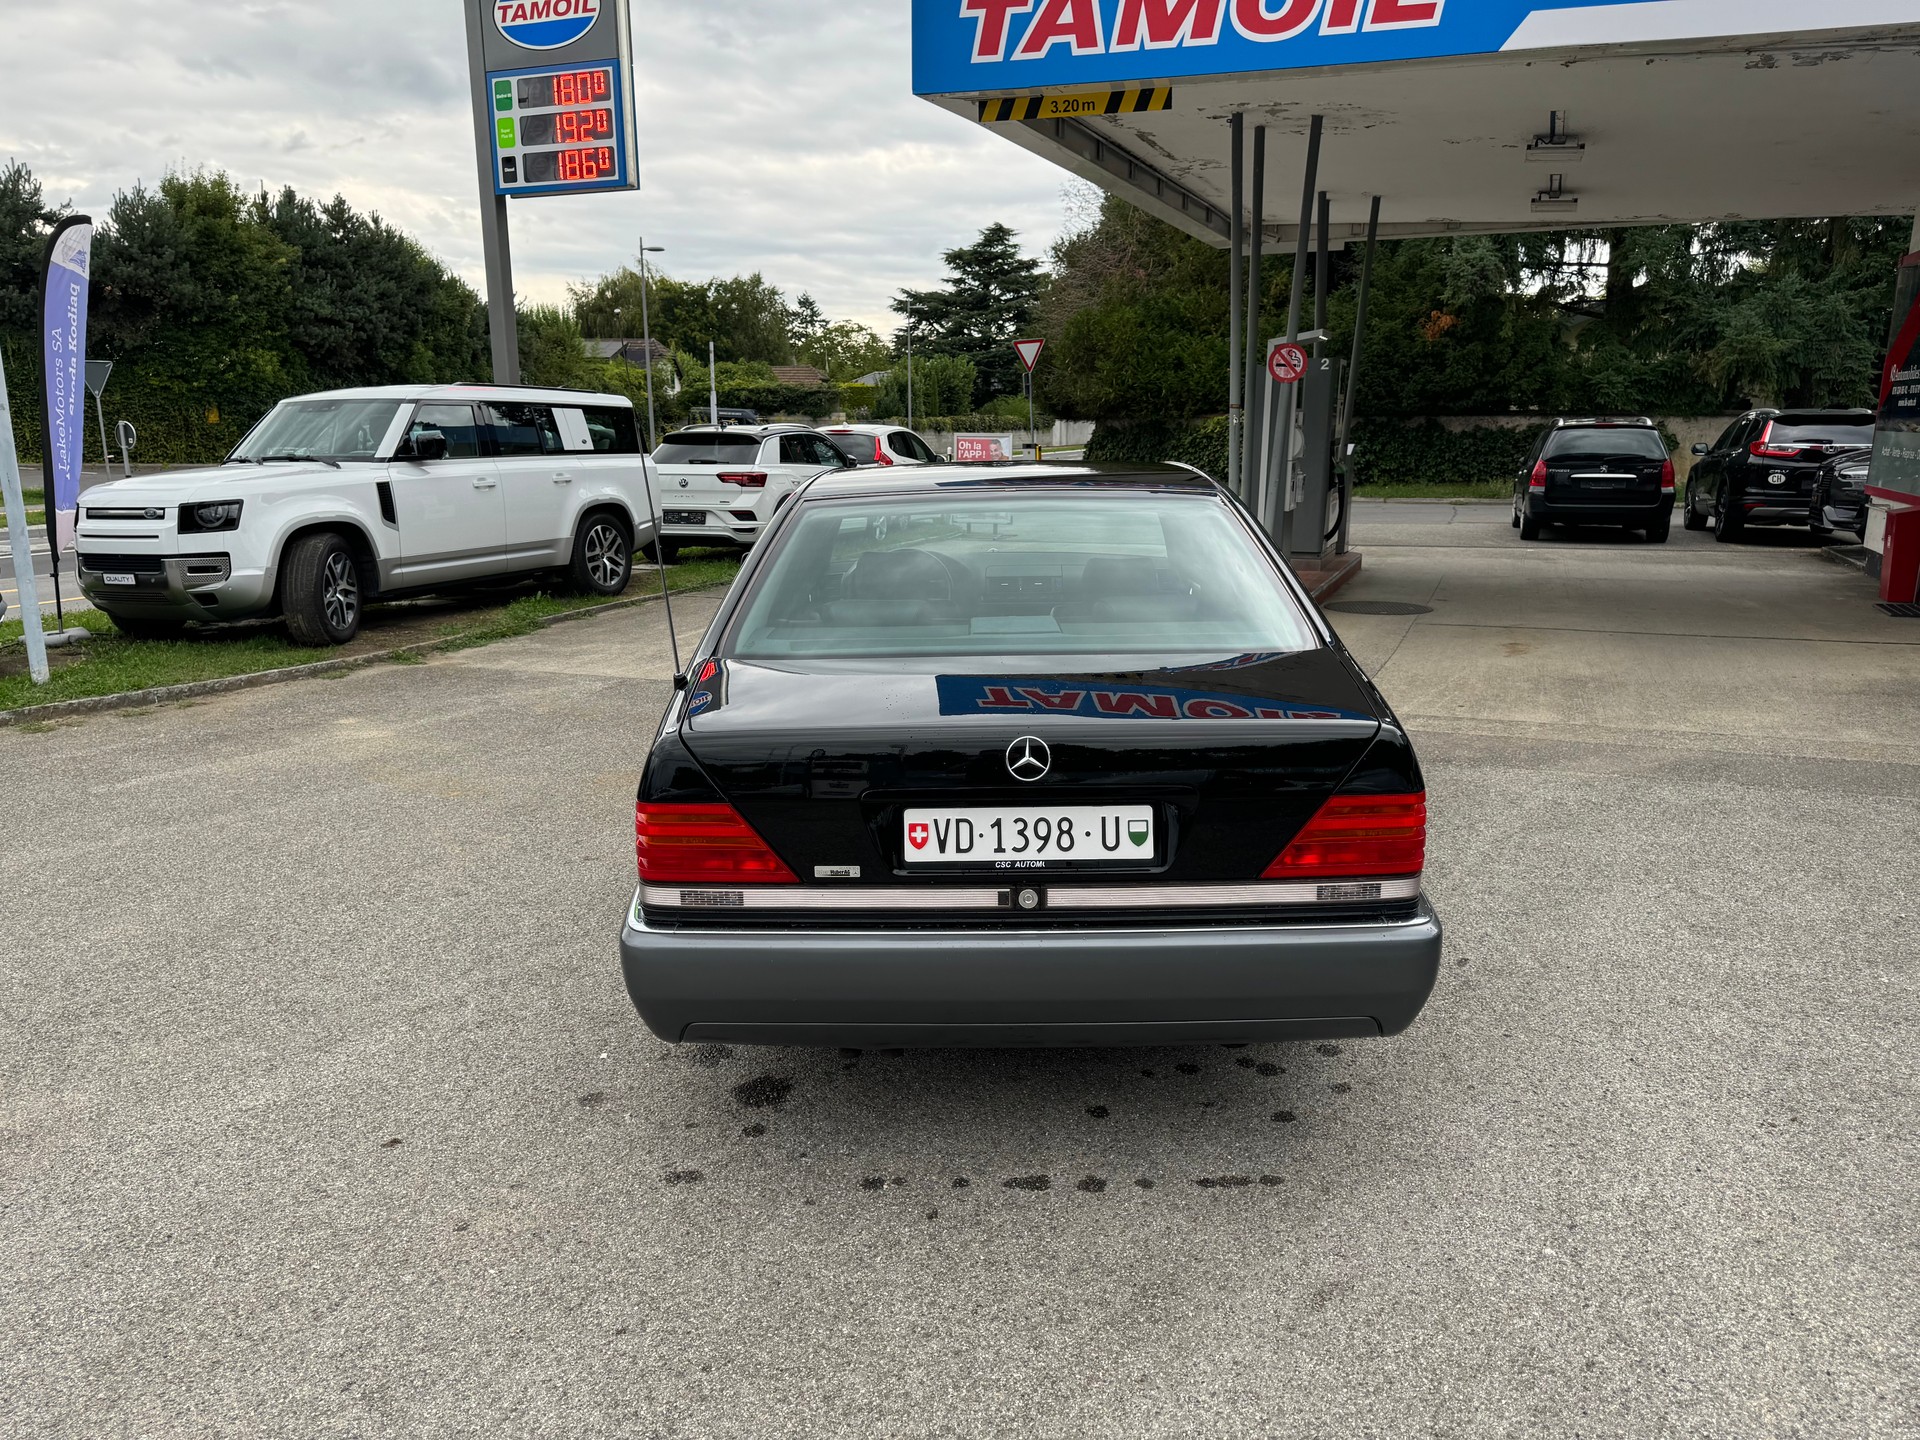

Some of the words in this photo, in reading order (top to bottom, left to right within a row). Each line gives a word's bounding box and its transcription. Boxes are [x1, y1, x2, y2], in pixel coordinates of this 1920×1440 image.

[497, 0, 596, 23] TAMOIL
[1050, 99, 1079, 113] 3.20
[1082, 101, 1095, 111] m
[68, 283, 80, 352] Kodiaq
[52, 327, 62, 353] SA
[1320, 358, 1330, 370] 2
[55, 357, 67, 470] LakeMotors
[958, 441, 971, 450] Oh
[973, 441, 982, 450] la
[1771, 475, 1782, 483] CH
